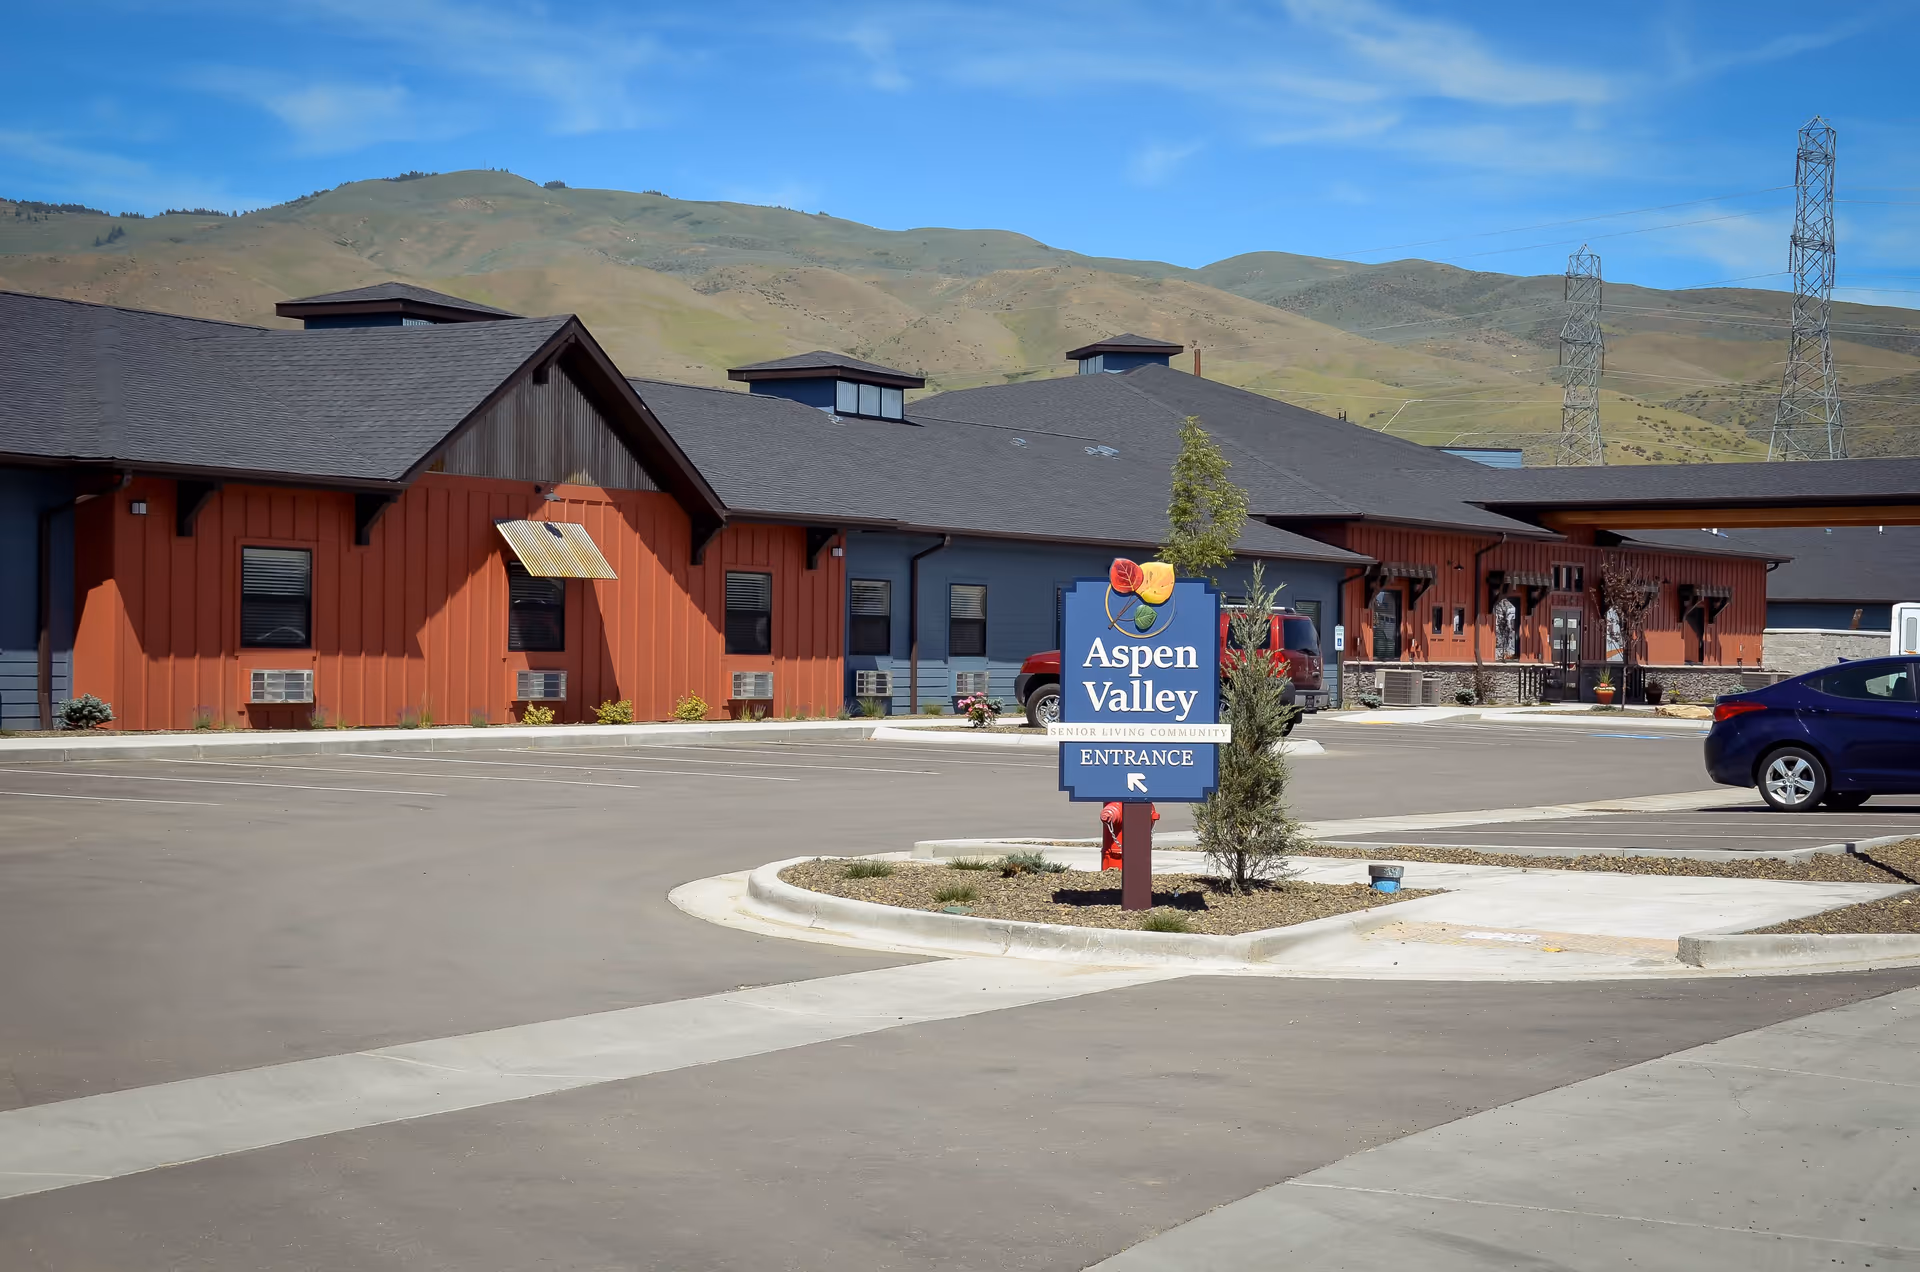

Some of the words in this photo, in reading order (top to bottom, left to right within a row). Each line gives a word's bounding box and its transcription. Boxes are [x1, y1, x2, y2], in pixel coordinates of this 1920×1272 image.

[1082, 637, 1198, 678] Aspen
[1082, 680, 1198, 721] Valley
[1050, 727, 1097, 737] SENIOR
[1102, 727, 1145, 737] LIVING
[1150, 727, 1228, 738] COMMUNITY
[1080, 749, 1194, 766] ENTRANCE
